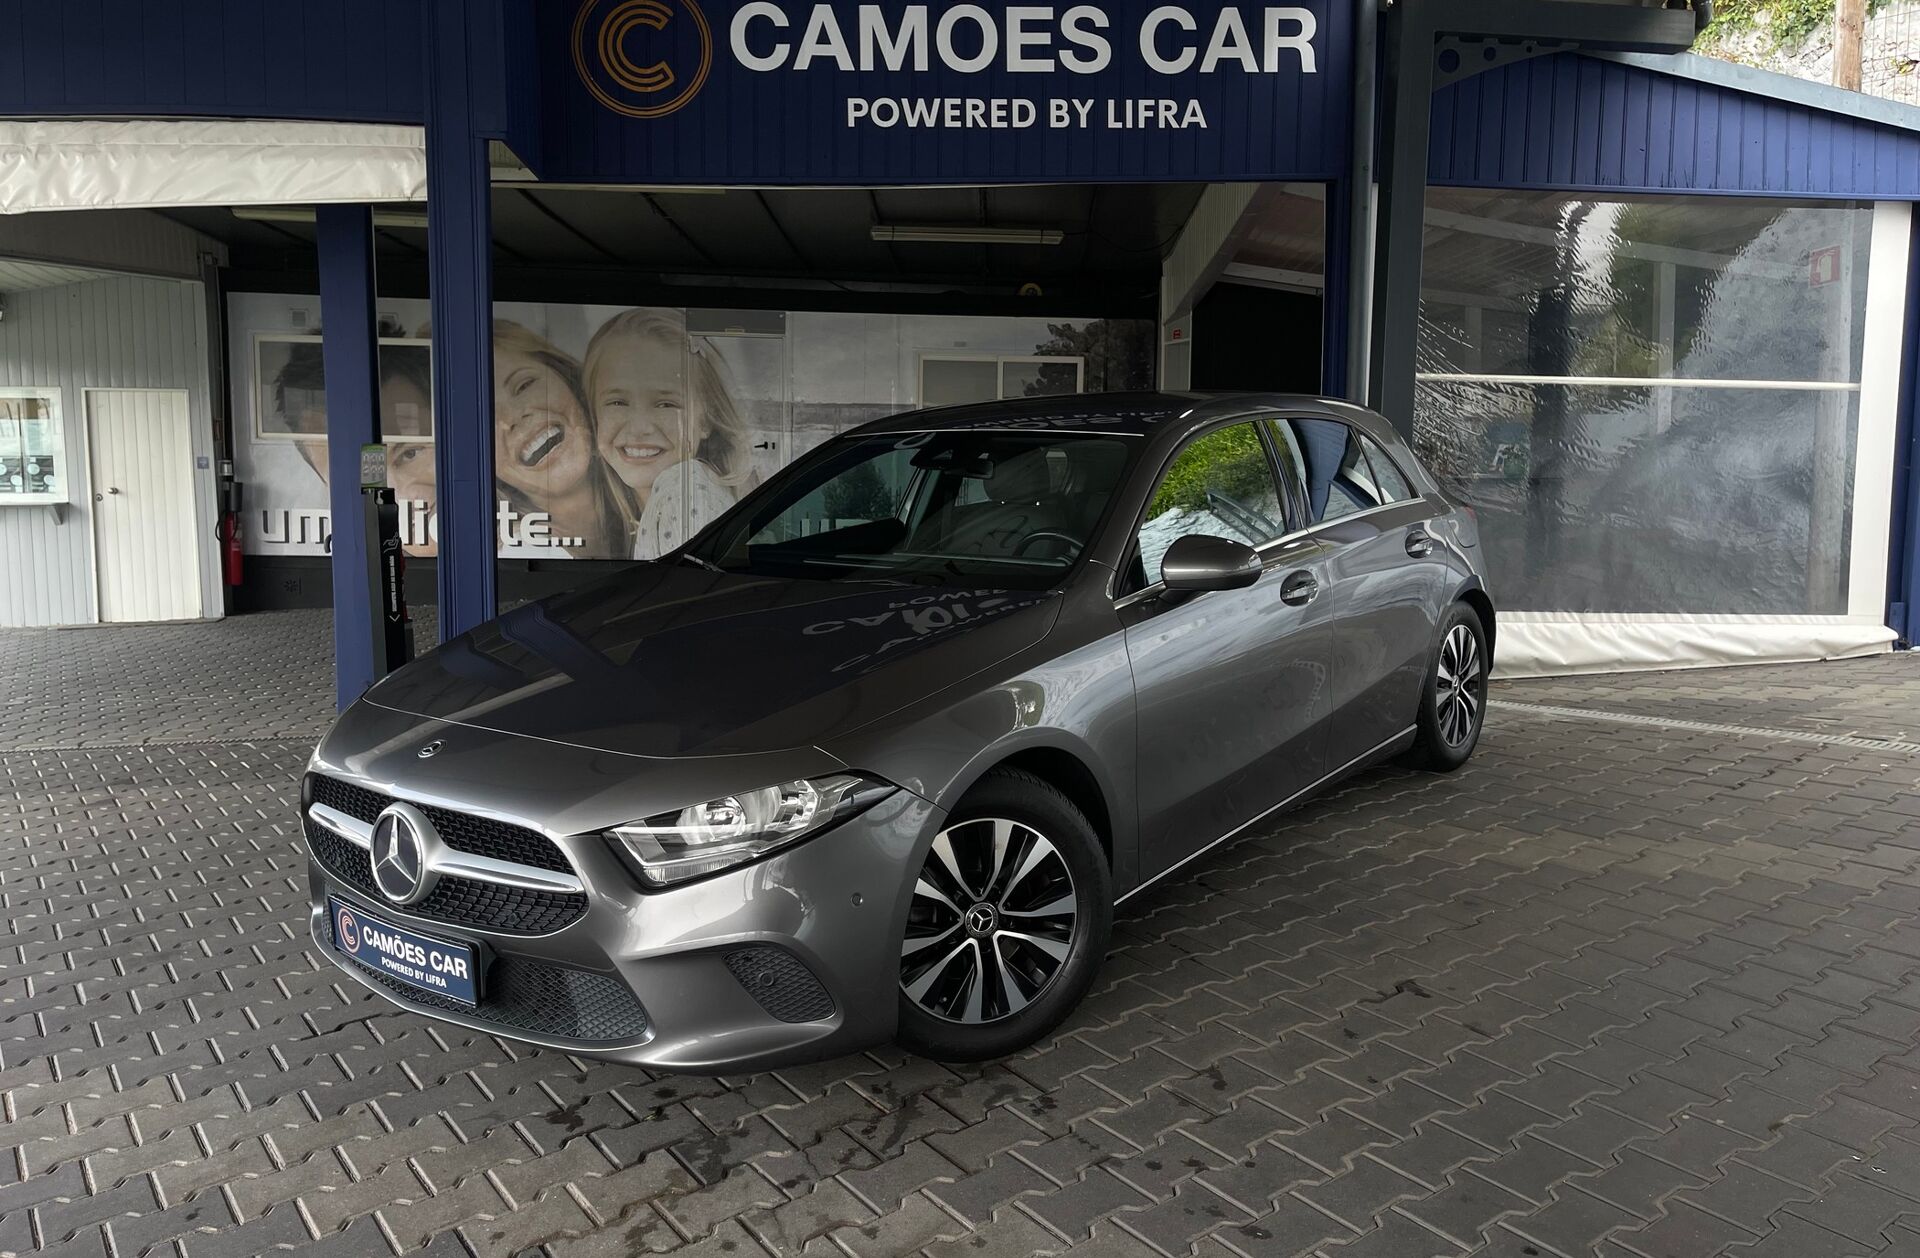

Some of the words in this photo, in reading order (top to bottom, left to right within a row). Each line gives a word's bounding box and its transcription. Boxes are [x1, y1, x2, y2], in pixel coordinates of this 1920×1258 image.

[730, 1, 1112, 73] CAMOES
[1139, 5, 1317, 74] CAR
[847, 97, 1036, 129] POWERED
[1049, 98, 1095, 129] BY
[1107, 98, 1208, 129] LIFRA
[363, 925, 427, 967] CAMÕES
[429, 951, 468, 980] CAR
[381, 956, 414, 977] POWERED
[414, 969, 425, 981] BY
[425, 973, 447, 988] LIFRA
